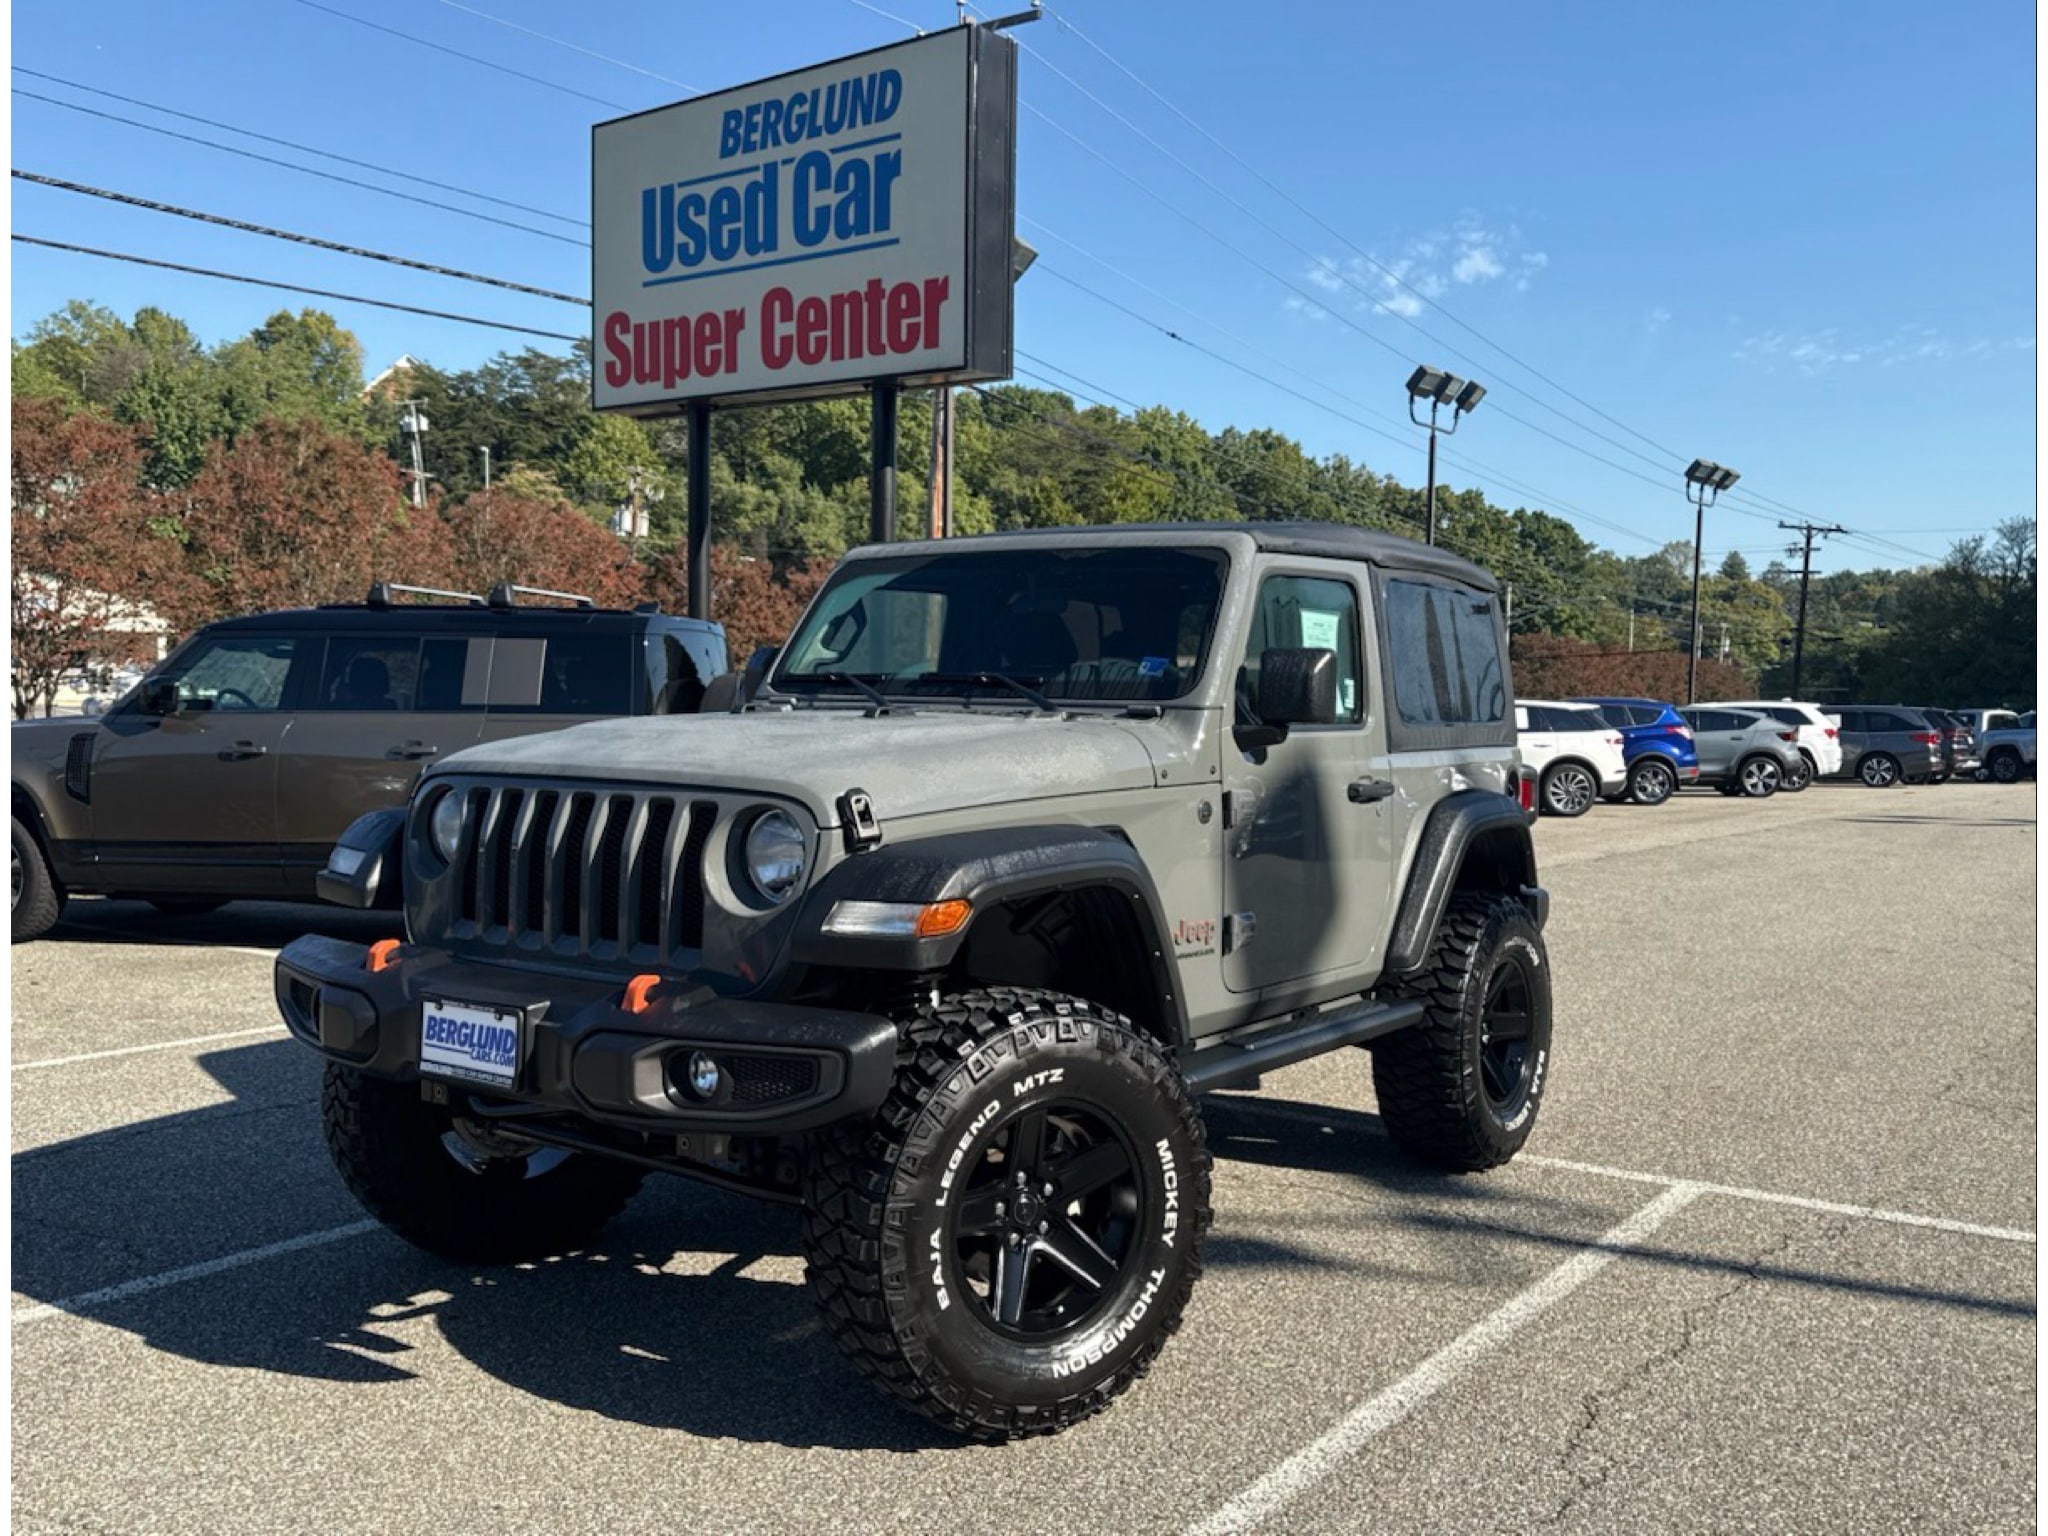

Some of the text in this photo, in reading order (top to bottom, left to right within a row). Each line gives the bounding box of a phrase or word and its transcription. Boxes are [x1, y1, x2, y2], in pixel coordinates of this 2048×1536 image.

[719, 68, 903, 159] BERGLUND
[641, 148, 902, 274] Used Car
[604, 275, 950, 390] Super Center
[1171, 918, 1215, 946] Jeep
[425, 1014, 516, 1054] BERGLUND
[469, 1047, 515, 1068] CARS.COM
[928, 1067, 1066, 1311] BAJA LEGEND MTZ
[1052, 1137, 1180, 1379] MICKEY THOMPSON
